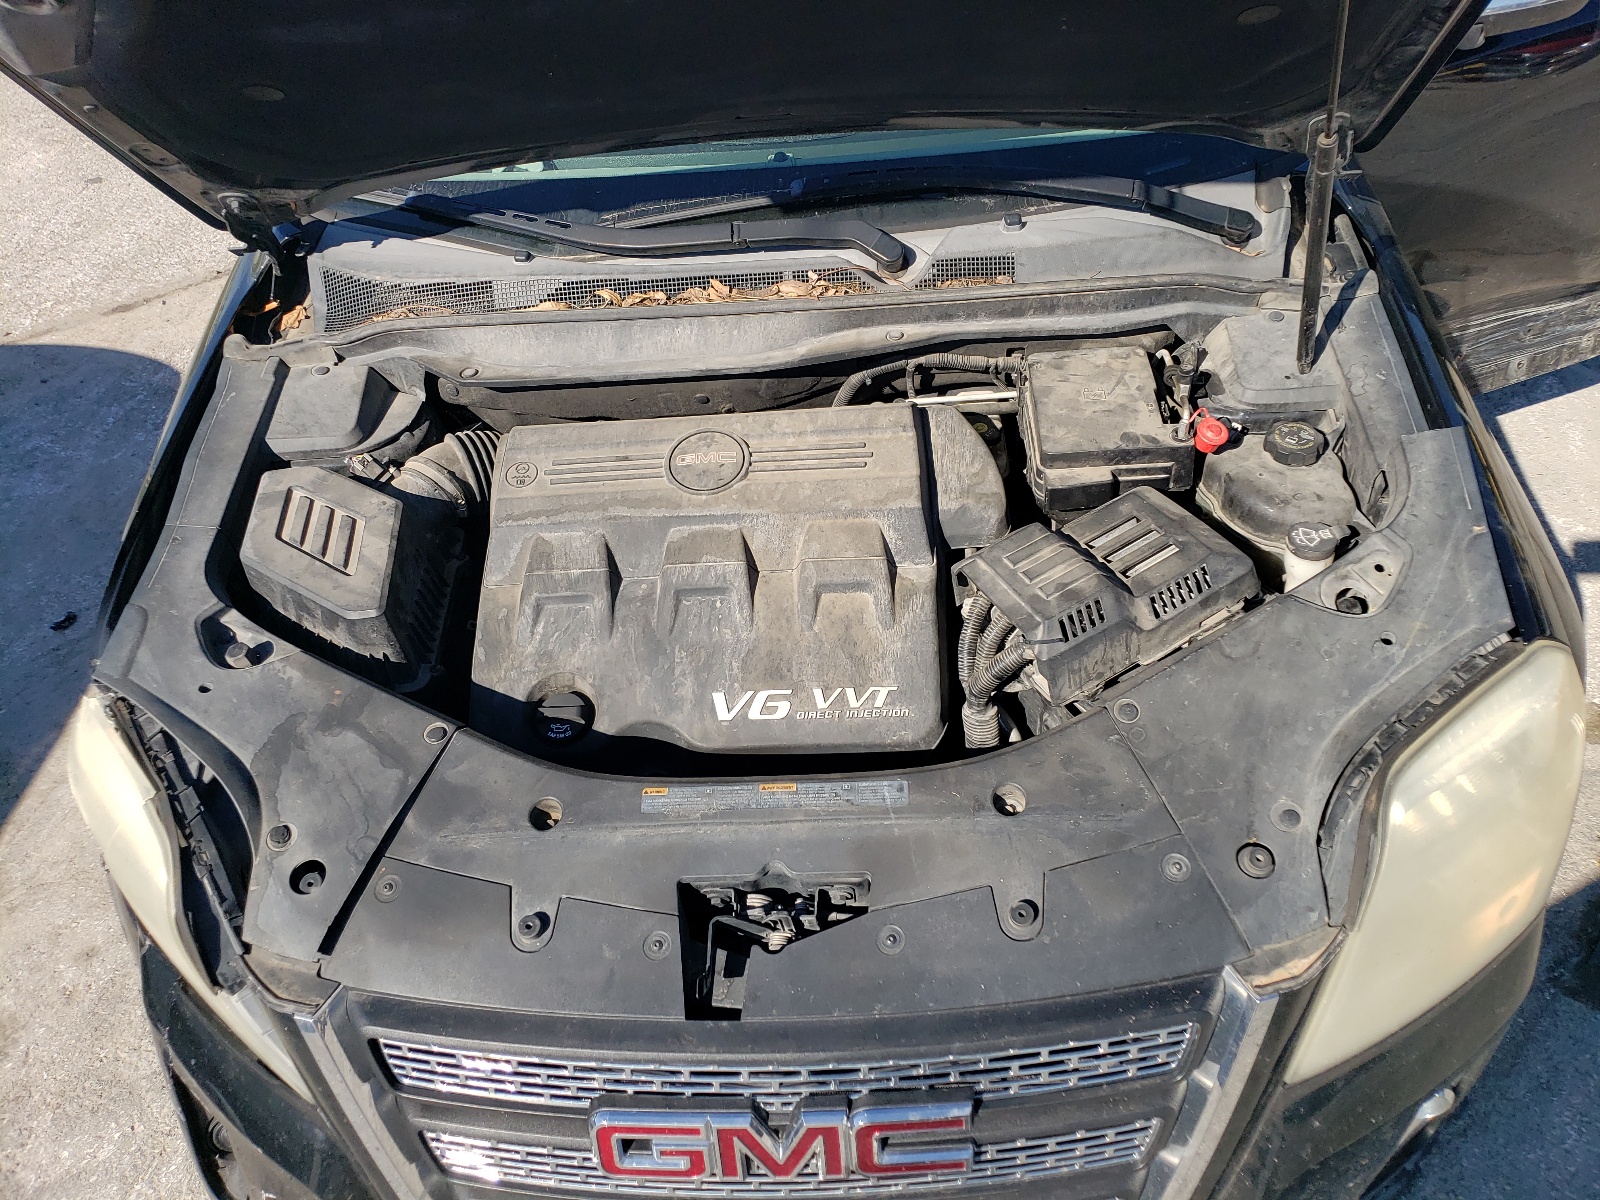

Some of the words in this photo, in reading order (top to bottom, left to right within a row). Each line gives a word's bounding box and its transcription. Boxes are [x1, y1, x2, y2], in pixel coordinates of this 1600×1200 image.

[676, 451, 737, 466] GMC
[711, 689, 794, 722] V6
[812, 686, 900, 710] VVT
[796, 709, 843, 720] DIRECT
[845, 708, 910, 719] INJECTION
[591, 1102, 974, 1181] GMC
